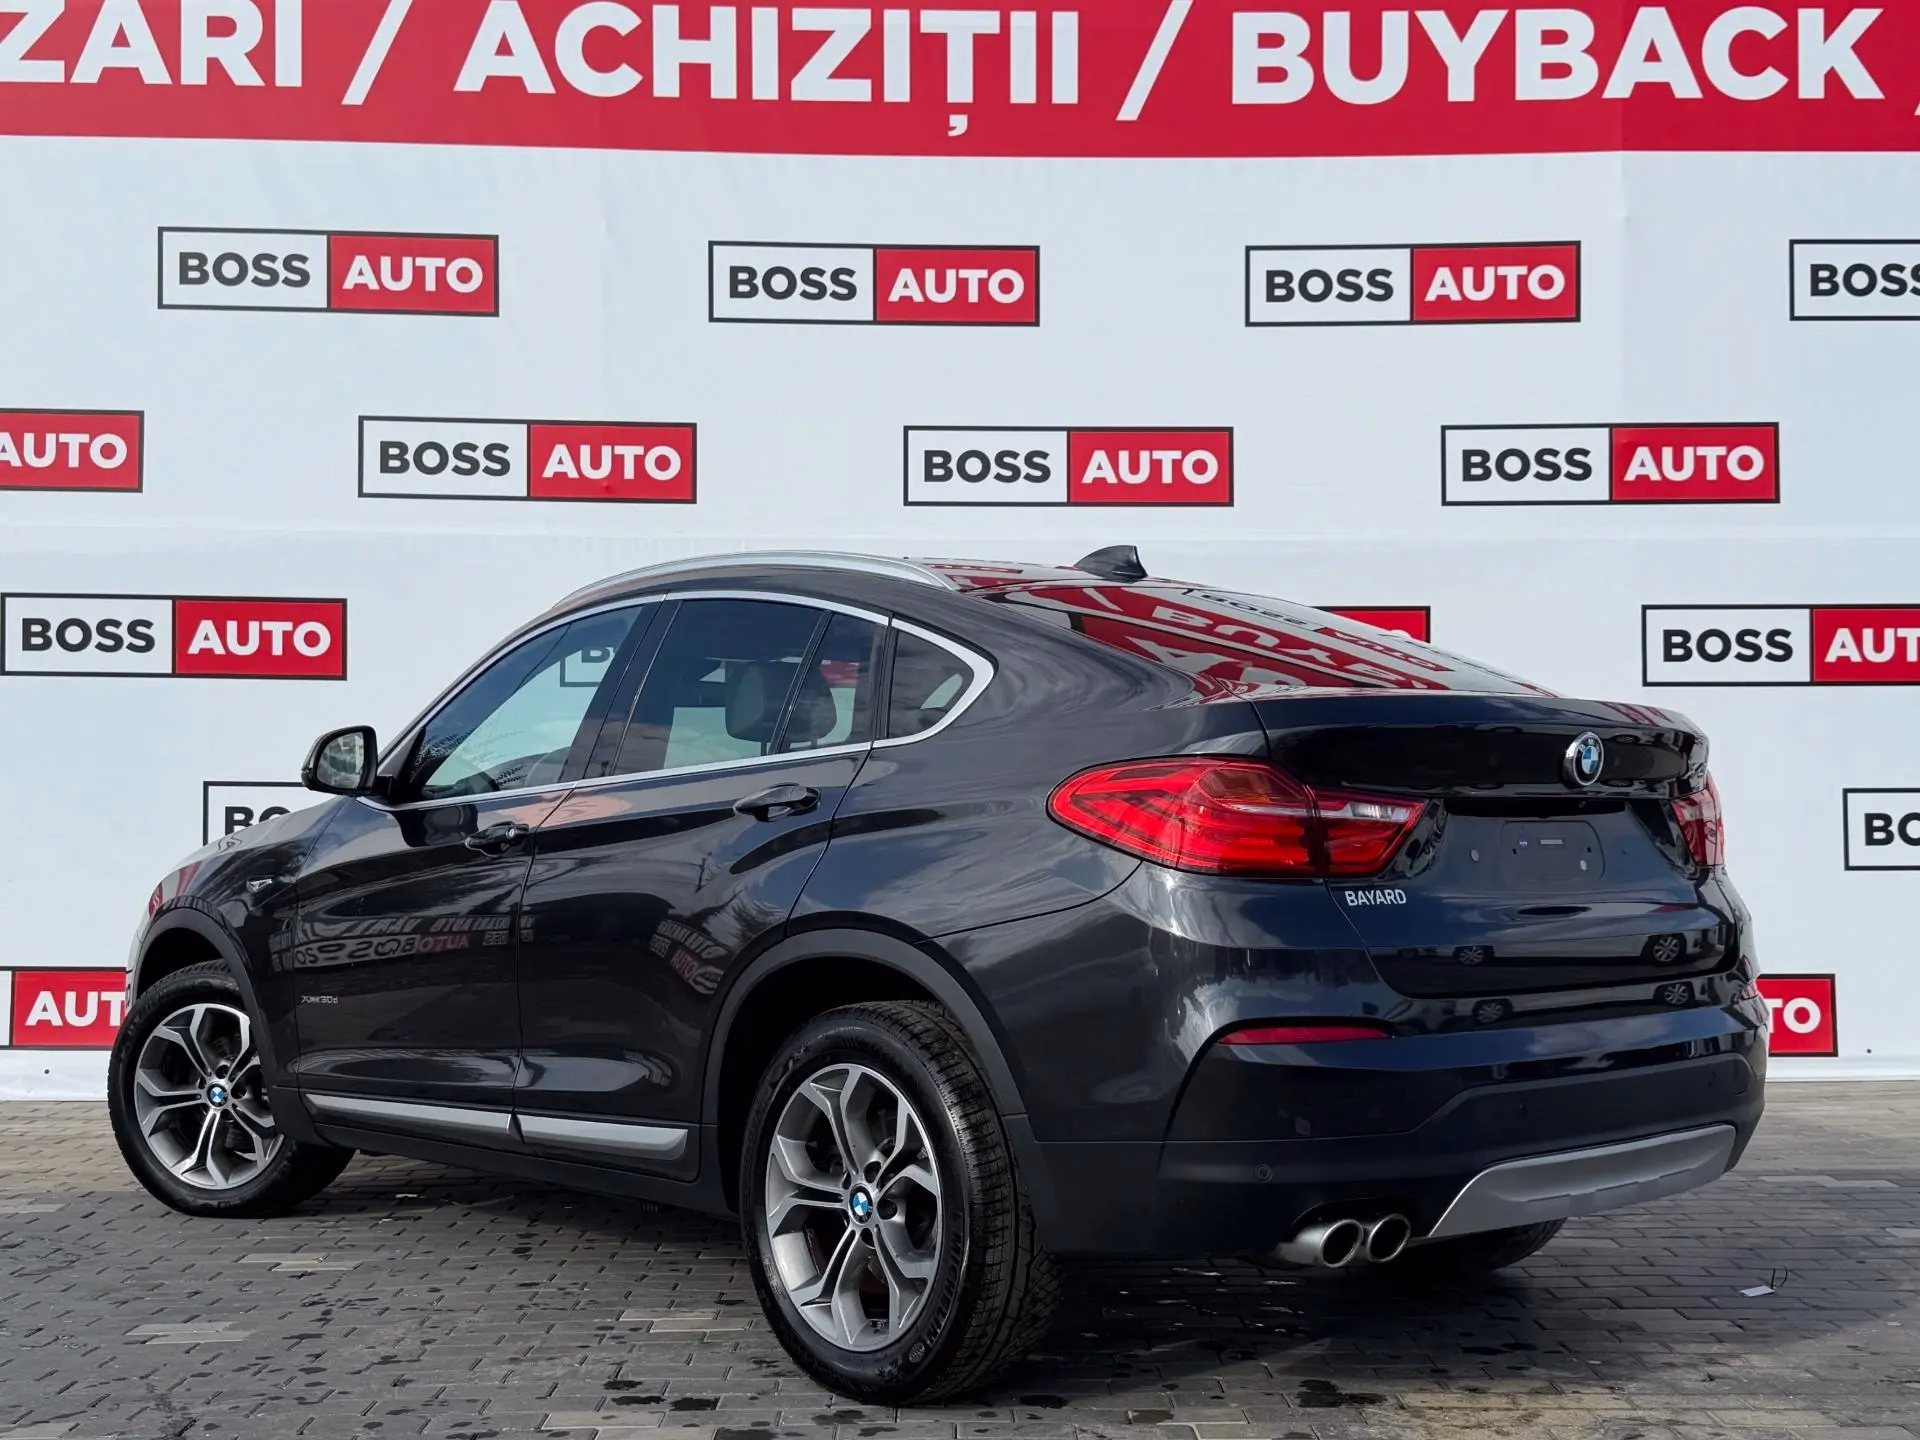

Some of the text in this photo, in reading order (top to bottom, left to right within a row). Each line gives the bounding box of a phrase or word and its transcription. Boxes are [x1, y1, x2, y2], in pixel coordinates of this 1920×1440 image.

[1232, 7, 1884, 104] BUYBACK
[180, 252, 483, 293] BOSS AUTO
[730, 266, 1024, 303] BOSS AUTO
[1266, 265, 1564, 302] BOSS AUTO
[0, 432, 127, 469] AUTO
[380, 441, 681, 480] BOSS AUTO
[925, 450, 1218, 484] BOSS AUTO
[1463, 446, 1763, 481] BOSS AUTO
[22, 618, 330, 656] BOSS AUTO
[1663, 628, 1920, 662] BOSS AUT
[1345, 889, 1407, 906] BAYARD
[25, 991, 125, 1026] AUT
[1763, 998, 1820, 1033] TO
